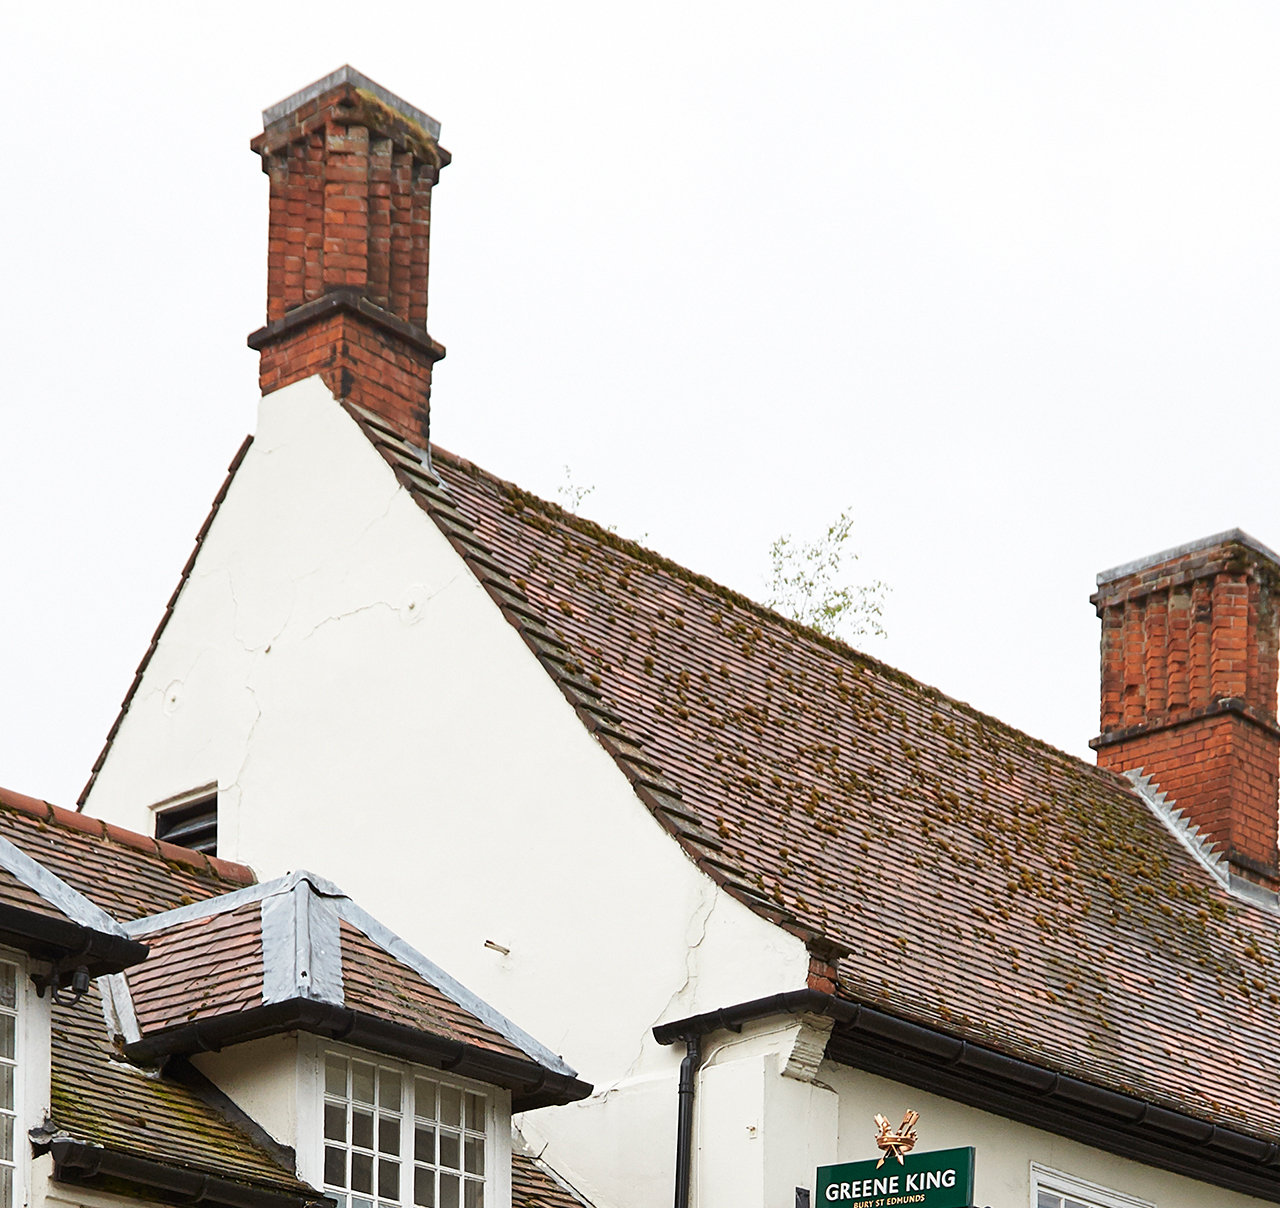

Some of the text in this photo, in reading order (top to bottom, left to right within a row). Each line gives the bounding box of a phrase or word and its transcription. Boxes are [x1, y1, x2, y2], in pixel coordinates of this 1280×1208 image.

[825, 1169, 956, 1201] GREENE KING
[875, 1198, 885, 1208] ST
[886, 1193, 926, 1206] EDMUNDS
